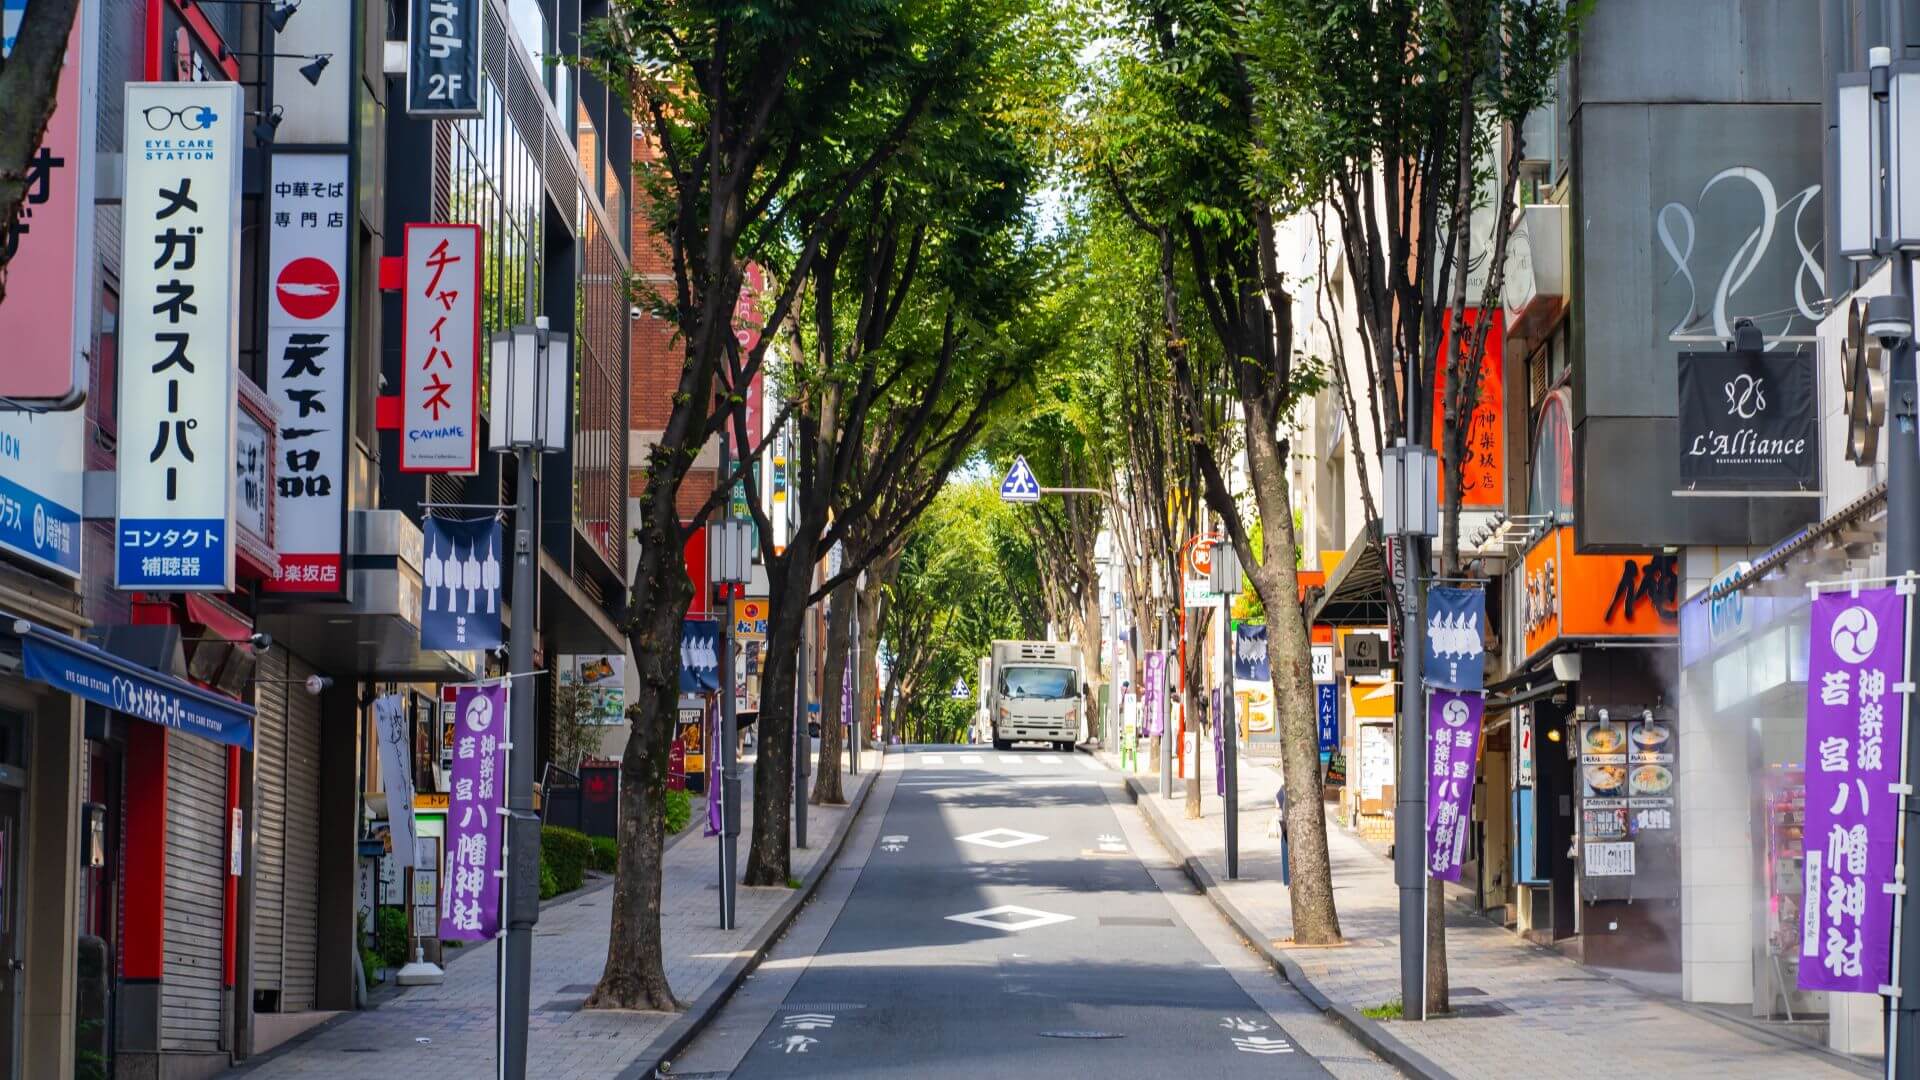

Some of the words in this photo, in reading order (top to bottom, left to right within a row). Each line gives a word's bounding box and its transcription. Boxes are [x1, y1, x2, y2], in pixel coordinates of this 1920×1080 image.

[428, 74, 462, 100] 2F
[145, 140, 171, 148] EYE
[178, 140, 214, 148] CARE
[145, 152, 214, 160] STATION
[274, 181, 344, 198] 中華そば
[274, 212, 344, 228] 専門店
[150, 178, 204, 501] メガネスーパー
[276, 333, 331, 498] 天下一品
[1479, 410, 1496, 488] 神楽坂店
[1689, 429, 1806, 456] L'Alliance
[124, 529, 220, 549] コンタクト
[141, 556, 201, 577] 補聴器
[137, 686, 186, 729] メガネスーパー
[1322, 685, 1332, 740] たんす屋
[1856, 668, 1885, 771] 神楽坂
[478, 734, 496, 799] 神楽坂
[453, 736, 488, 931] 若宮八幡神社
[1819, 670, 1870, 978] 若宮八幡神社
